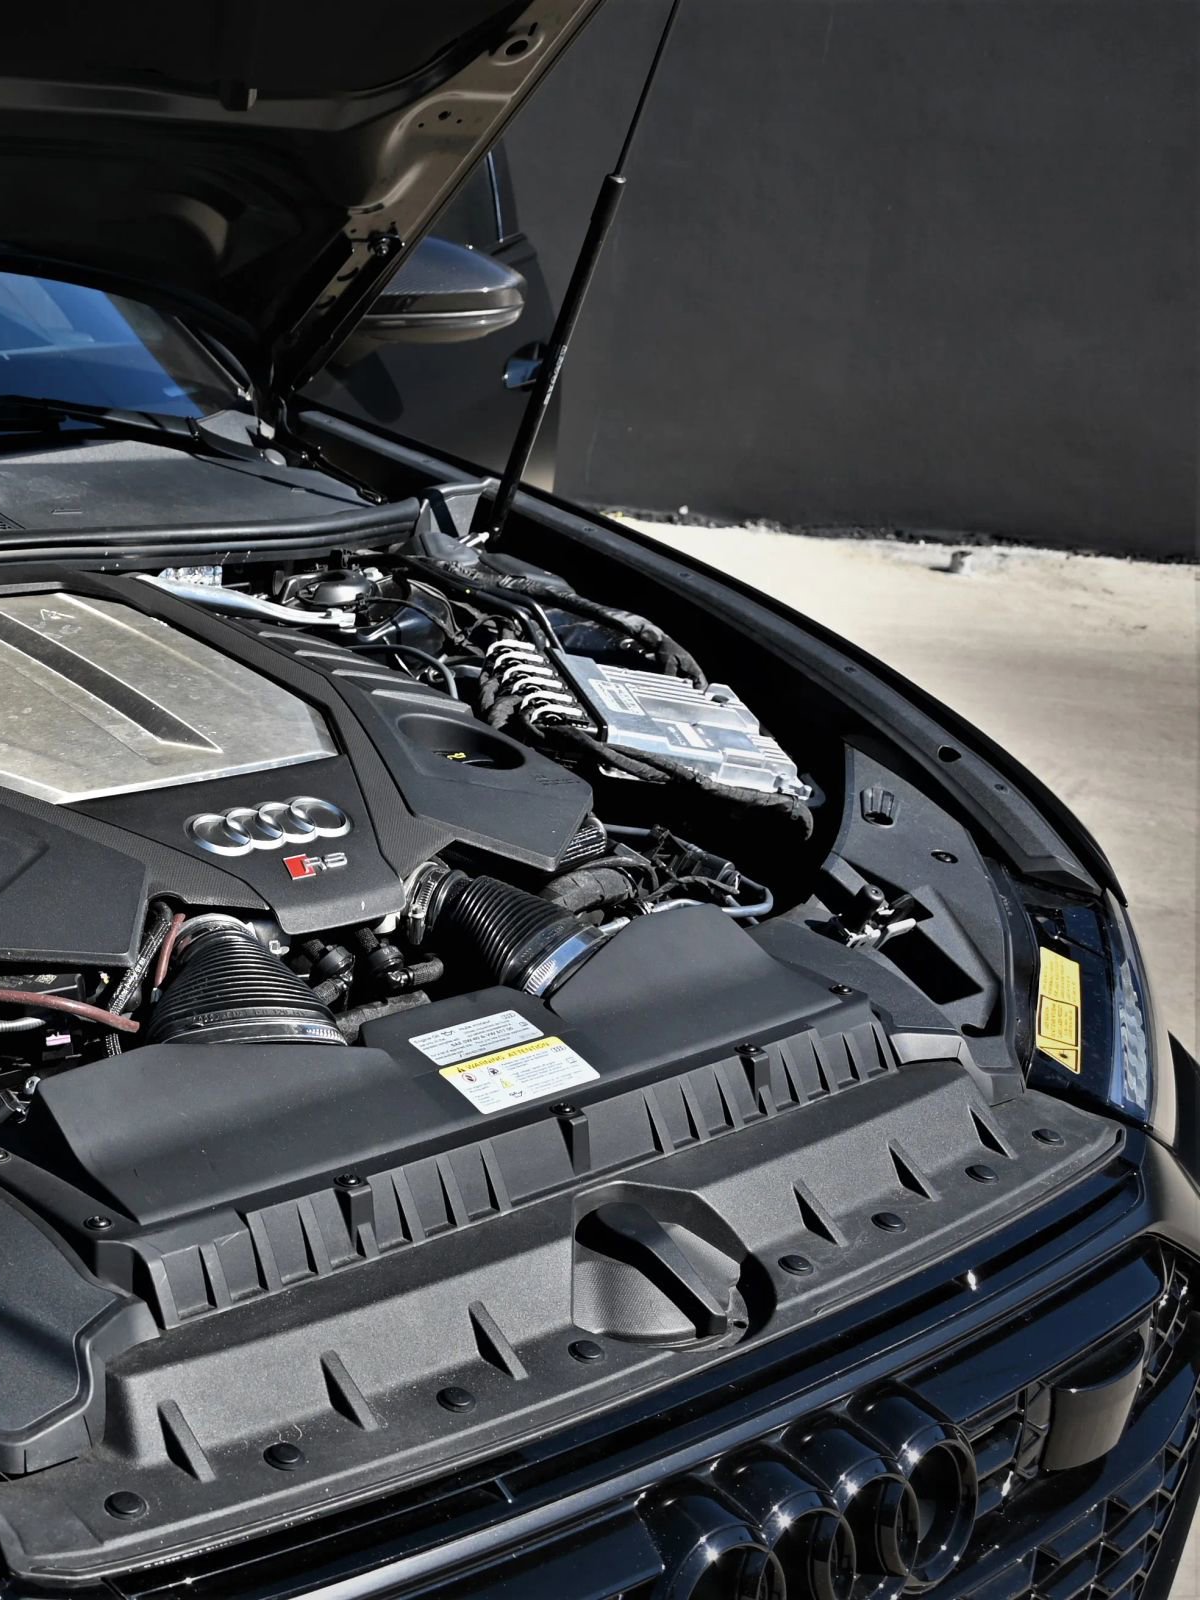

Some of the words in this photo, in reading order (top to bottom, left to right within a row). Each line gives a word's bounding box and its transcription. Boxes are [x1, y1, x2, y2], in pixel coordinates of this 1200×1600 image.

[303, 853, 348, 874] RS
[465, 1056, 505, 1070] WARNING
[507, 1041, 550, 1056] ATTENTION
